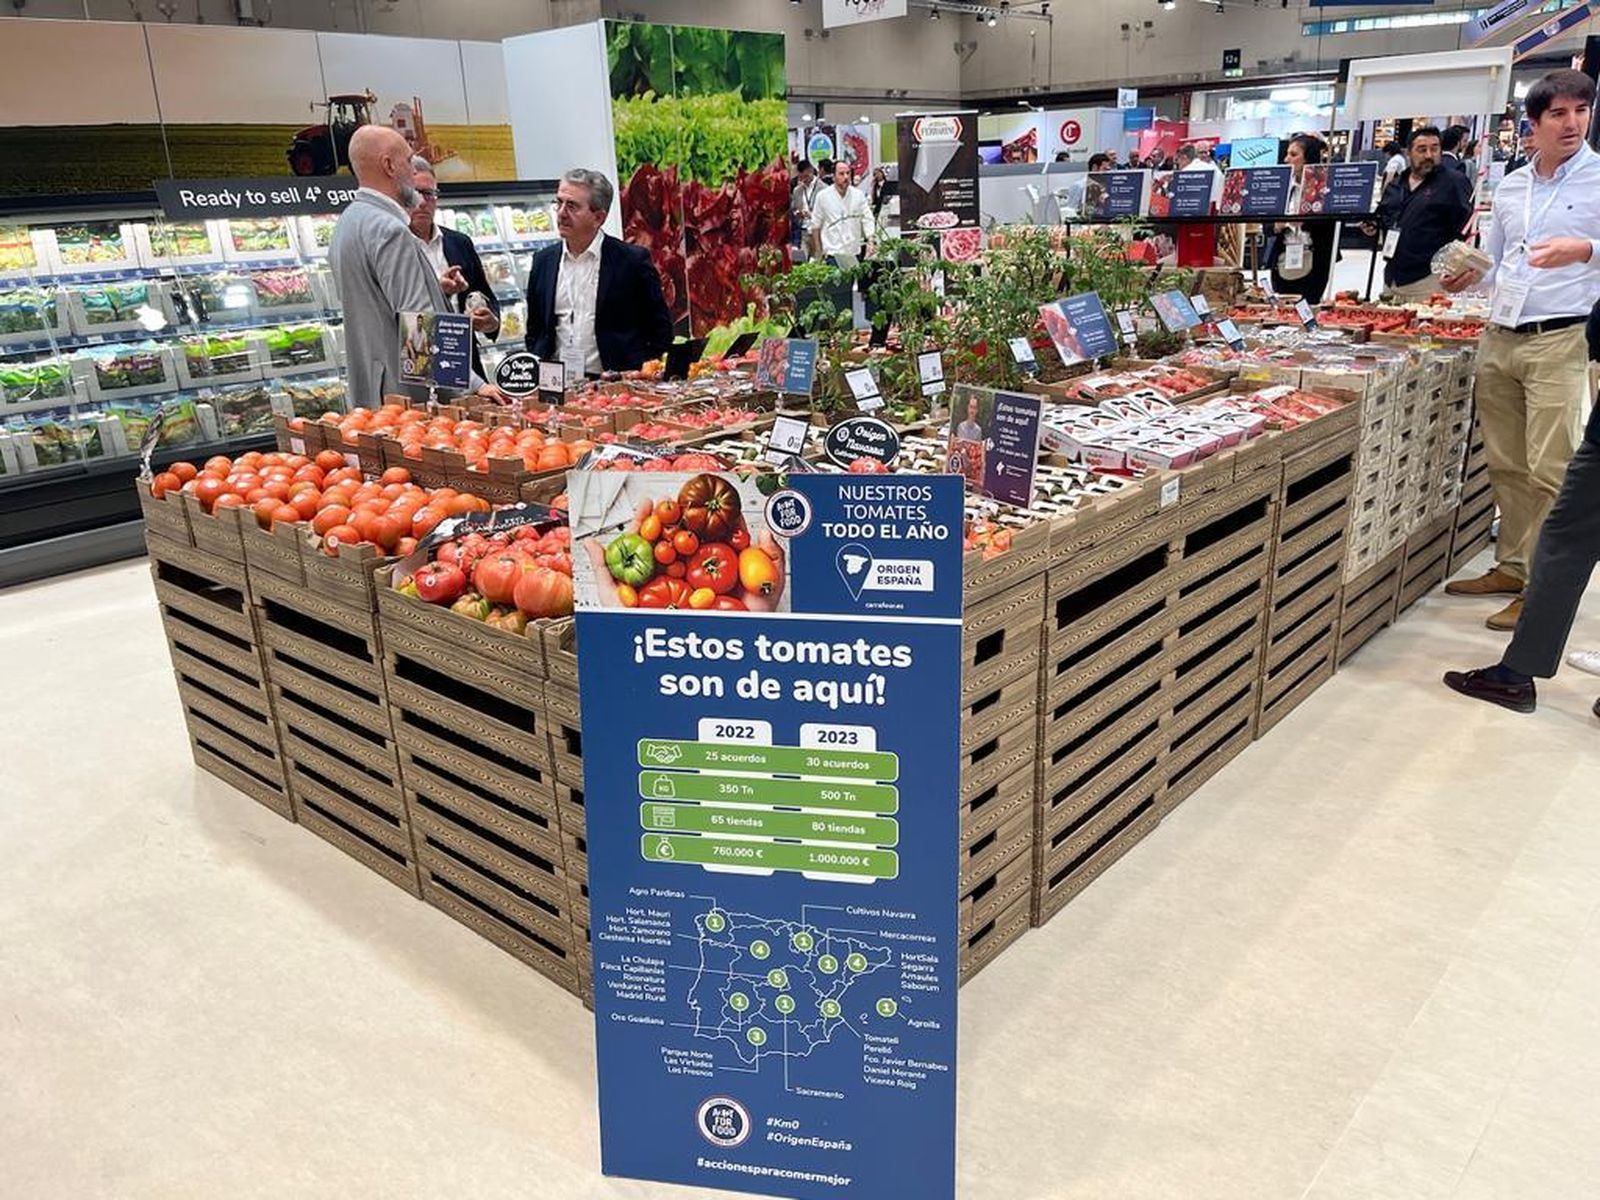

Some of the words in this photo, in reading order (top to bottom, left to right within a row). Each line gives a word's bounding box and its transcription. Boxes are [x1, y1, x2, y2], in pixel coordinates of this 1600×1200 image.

[179, 189, 242, 208] Ready
[245, 190, 266, 204] to
[270, 187, 301, 204] sell
[305, 186, 322, 202] 4ª
[855, 426, 886, 441] Origen
[846, 438, 885, 456] Navarra
[838, 486, 932, 502] NUESTROS
[844, 504, 926, 520] TOMATES
[822, 523, 876, 538] TODO
[880, 524, 902, 539] EL
[906, 522, 948, 540] AÑO
[876, 564, 921, 575] ORIGEN
[876, 573, 922, 586] ESPAÑA
[634, 628, 744, 663] ¡Estos
[754, 634, 912, 668] tomates
[660, 674, 723, 697] son
[736, 670, 780, 700] de
[793, 674, 886, 710] aquí!
[715, 725, 755, 739] 2022
[817, 731, 858, 745] 2023
[705, 751, 718, 762] 25
[720, 752, 766, 764] acuerdos
[806, 757, 820, 767] 30
[822, 759, 869, 771] acuerdos
[719, 784, 738, 794] 350
[740, 785, 754, 795] Tn
[821, 791, 841, 800] 500
[843, 791, 856, 801] Tn
[711, 815, 724, 824] 65
[726, 816, 763, 828] tiendas
[811, 821, 825, 832] 80
[828, 822, 866, 835] tiendas
[712, 847, 754, 857] 760.000
[756, 849, 763, 858] €
[809, 854, 859, 866] 1.000.000
[862, 857, 871, 866] €
[629, 887, 648, 897] Agro
[650, 888, 685, 898] Pardinas
[846, 906, 880, 917] Cultivos
[882, 910, 916, 920] Navarra
[628, 917, 671, 927] Salamanca
[901, 962, 934, 973] Segarra
[690, 1050, 713, 1060] Norte
[864, 1066, 889, 1075] Daniel
[864, 1076, 895, 1086] Vicente
[796, 1087, 844, 1099] Sacramento
[766, 1117, 800, 1130] #Km0
[767, 1133, 852, 1151] #OrigenEspaña
[697, 1157, 850, 1186] #accionesparacomermejor
